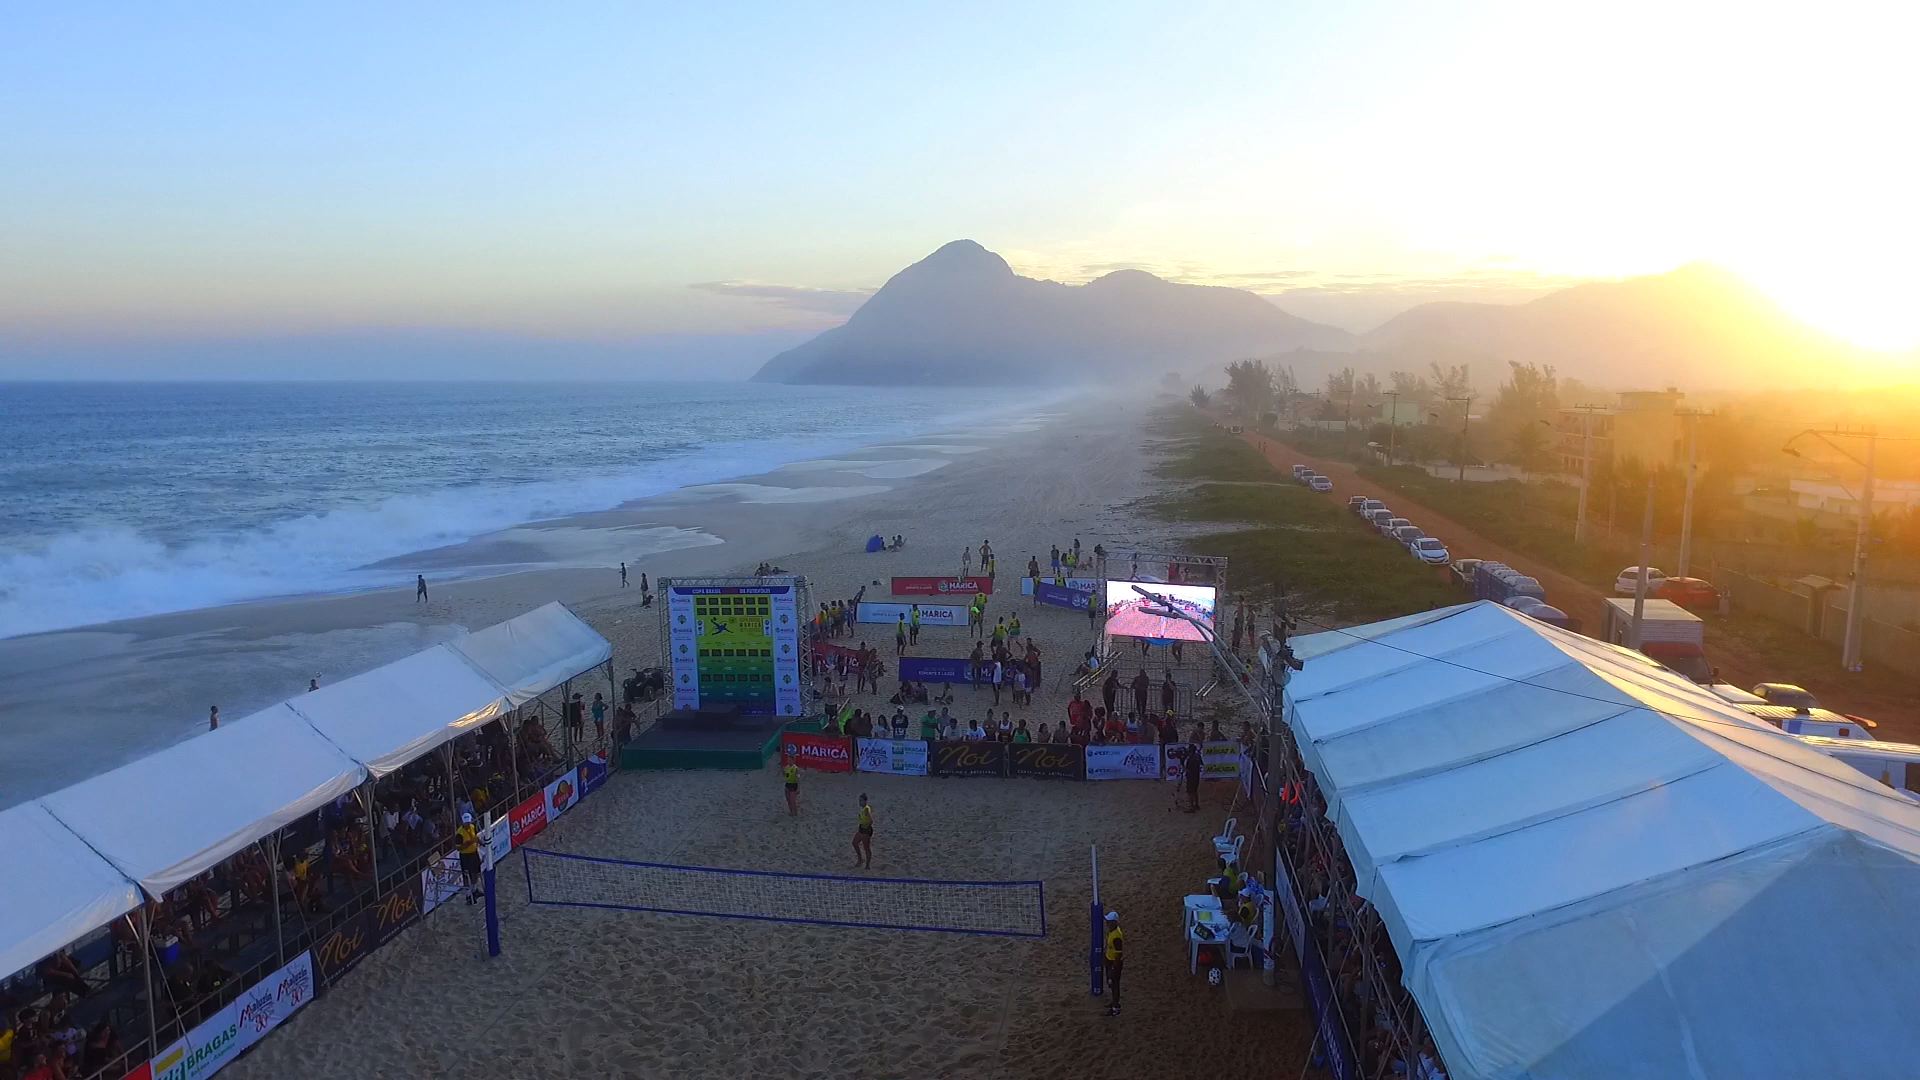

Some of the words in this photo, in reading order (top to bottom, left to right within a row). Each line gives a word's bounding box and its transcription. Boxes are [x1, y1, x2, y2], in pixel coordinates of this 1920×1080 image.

[938, 745, 998, 767] Noi
[1017, 747, 1075, 768] Noi
[187, 1023, 237, 1070] BRAGAS
